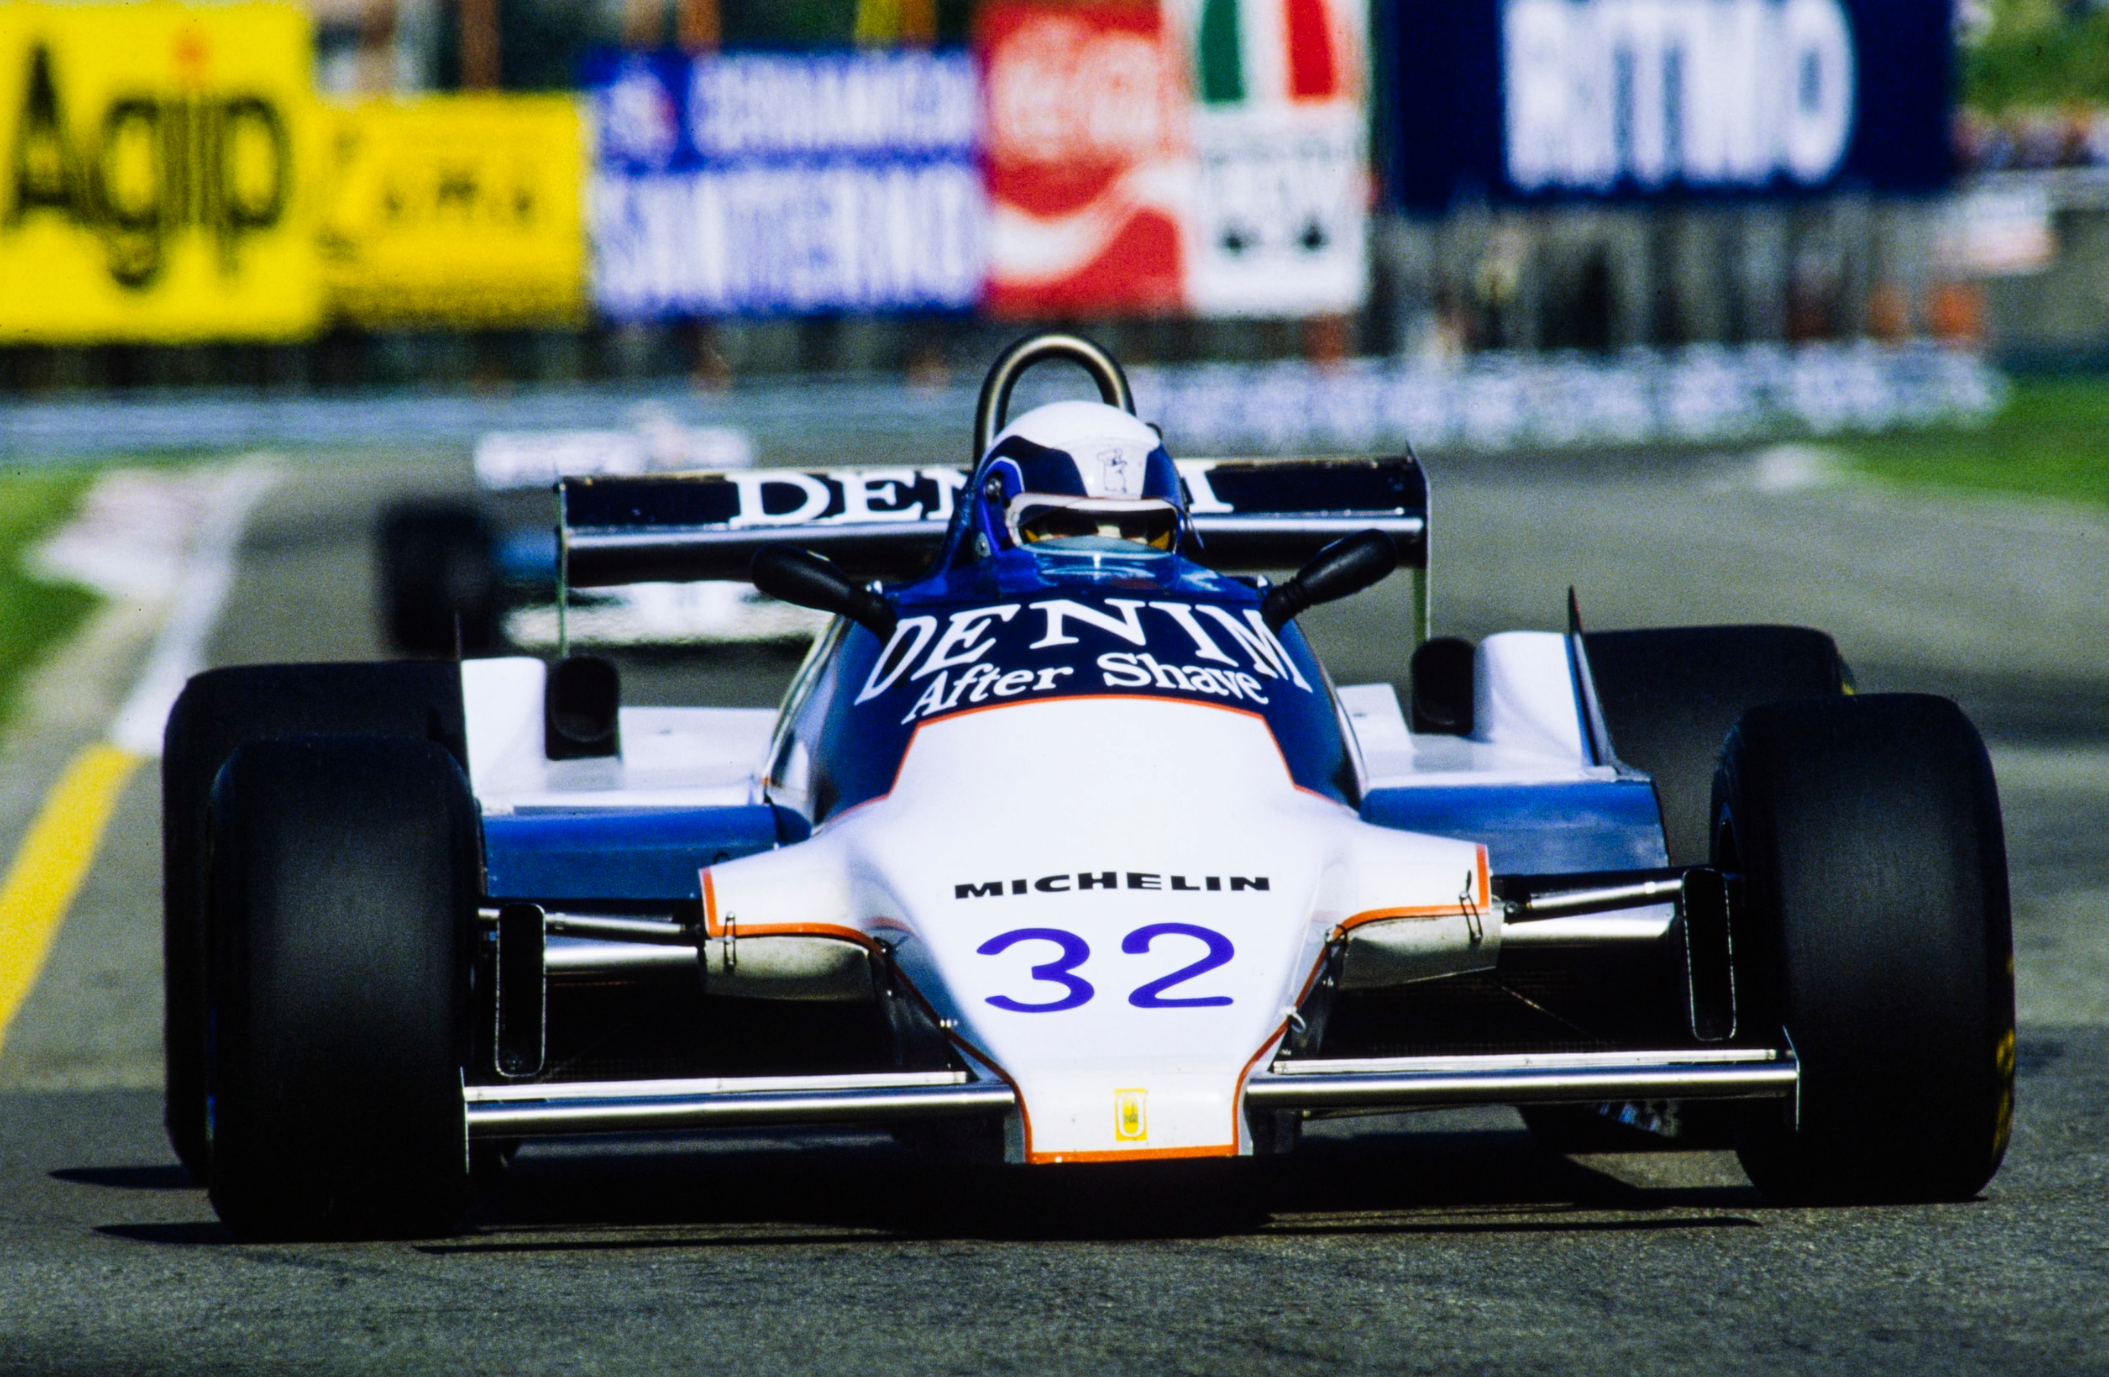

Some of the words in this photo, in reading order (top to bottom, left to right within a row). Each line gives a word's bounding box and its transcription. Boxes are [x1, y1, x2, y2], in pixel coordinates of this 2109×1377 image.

[4, 38, 294, 290] Agip
[853, 597, 1314, 706] DENIM
[900, 662, 1075, 725] After
[1096, 651, 1270, 705] Shave
[954, 870, 1270, 899] MICHELIN
[976, 922, 1235, 1013] 32
